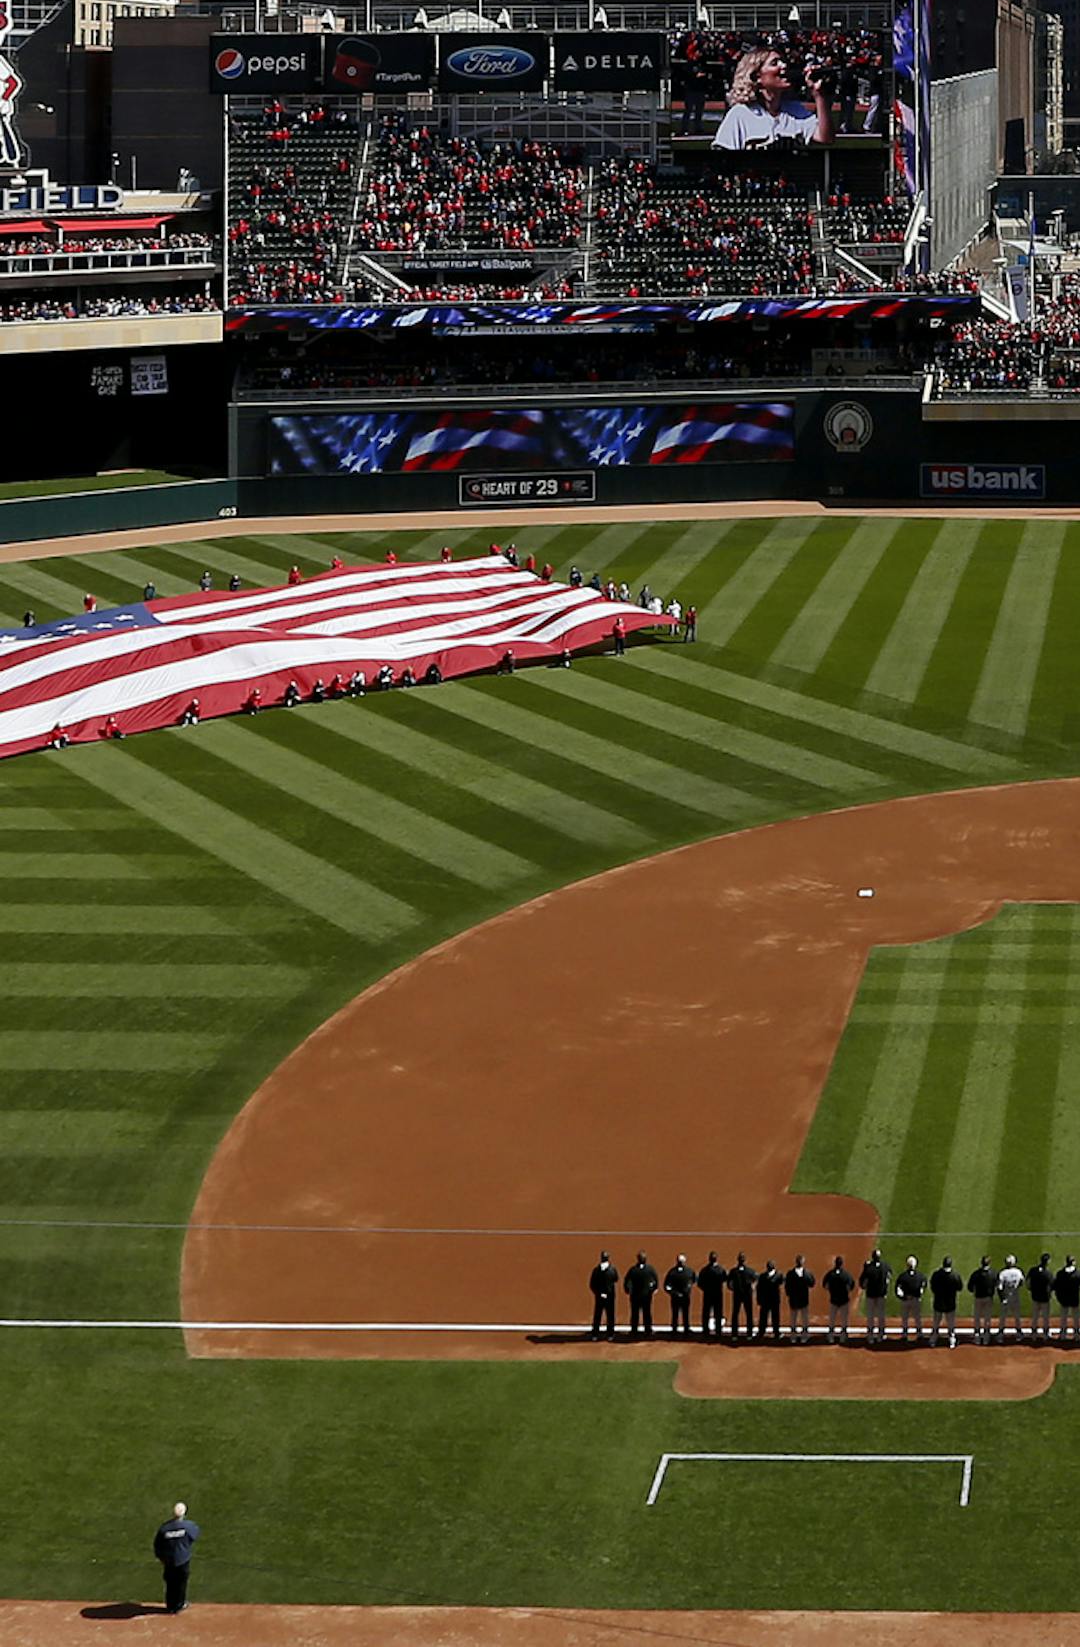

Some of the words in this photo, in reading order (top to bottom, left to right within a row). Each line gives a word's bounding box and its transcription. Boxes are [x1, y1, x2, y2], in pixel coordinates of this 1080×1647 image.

[247, 53, 306, 75] pepsi
[464, 51, 517, 73] Ford
[584, 55, 653, 68] DELTA
[3, 185, 124, 211] FIELD
[492, 258, 532, 270] Ballpark
[481, 481, 517, 496] HEART
[519, 481, 534, 494] OF
[536, 479, 558, 495] 29
